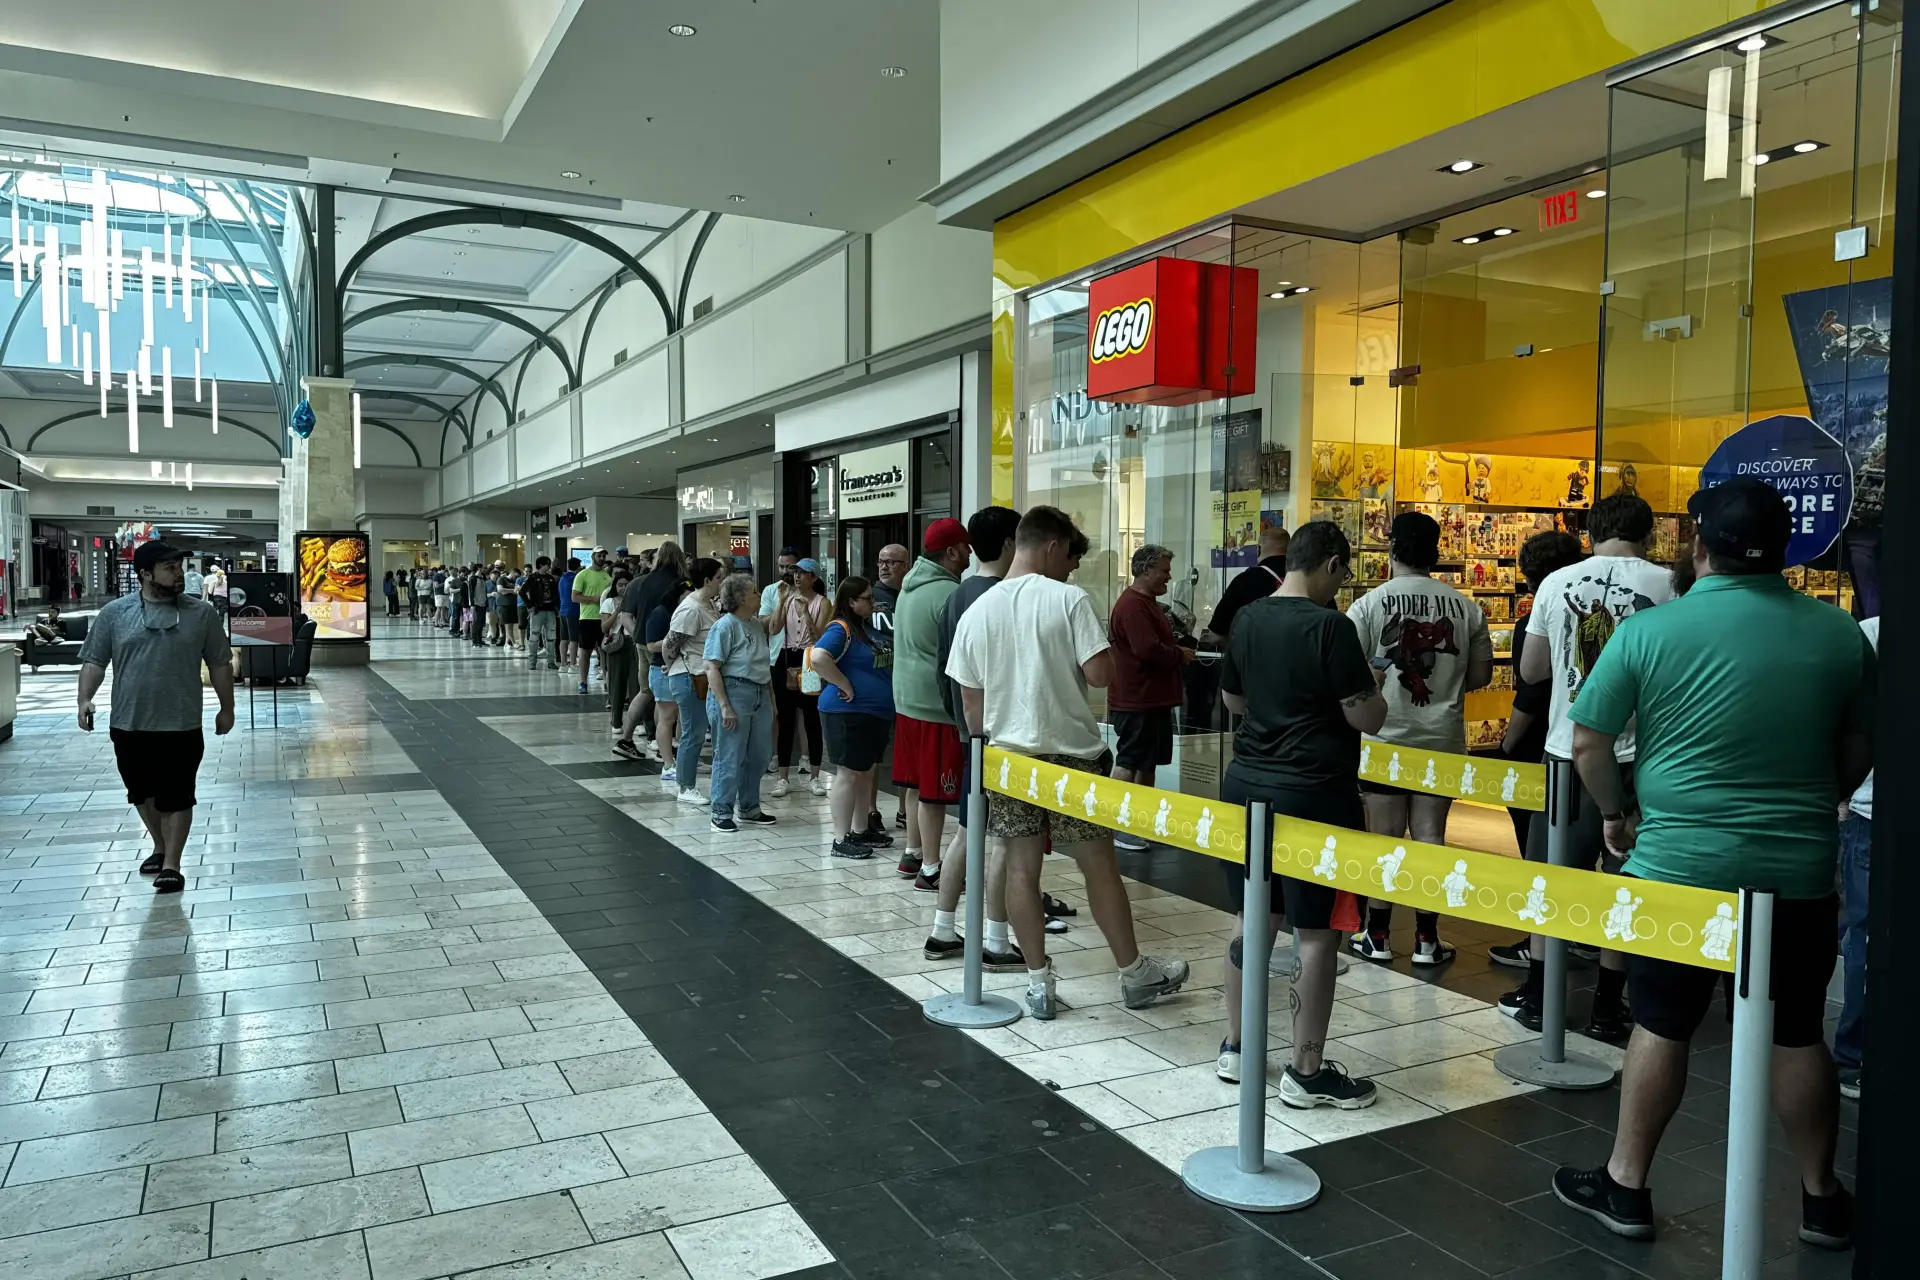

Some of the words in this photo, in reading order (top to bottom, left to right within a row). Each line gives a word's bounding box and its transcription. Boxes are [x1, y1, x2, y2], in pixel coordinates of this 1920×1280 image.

[1092, 299, 1152, 362] LEGO
[1233, 425, 1249, 436] GIFT
[1737, 460, 1813, 475] DISCOVER
[840, 466, 904, 491] francesca's
[1777, 476, 1819, 490] WAYS
[1824, 475, 1843, 488] TO
[848, 491, 897, 503] COLLECTIONS
[1231, 501, 1247, 511] GIFT
[1381, 594, 1464, 620] SPIDER-MAN
